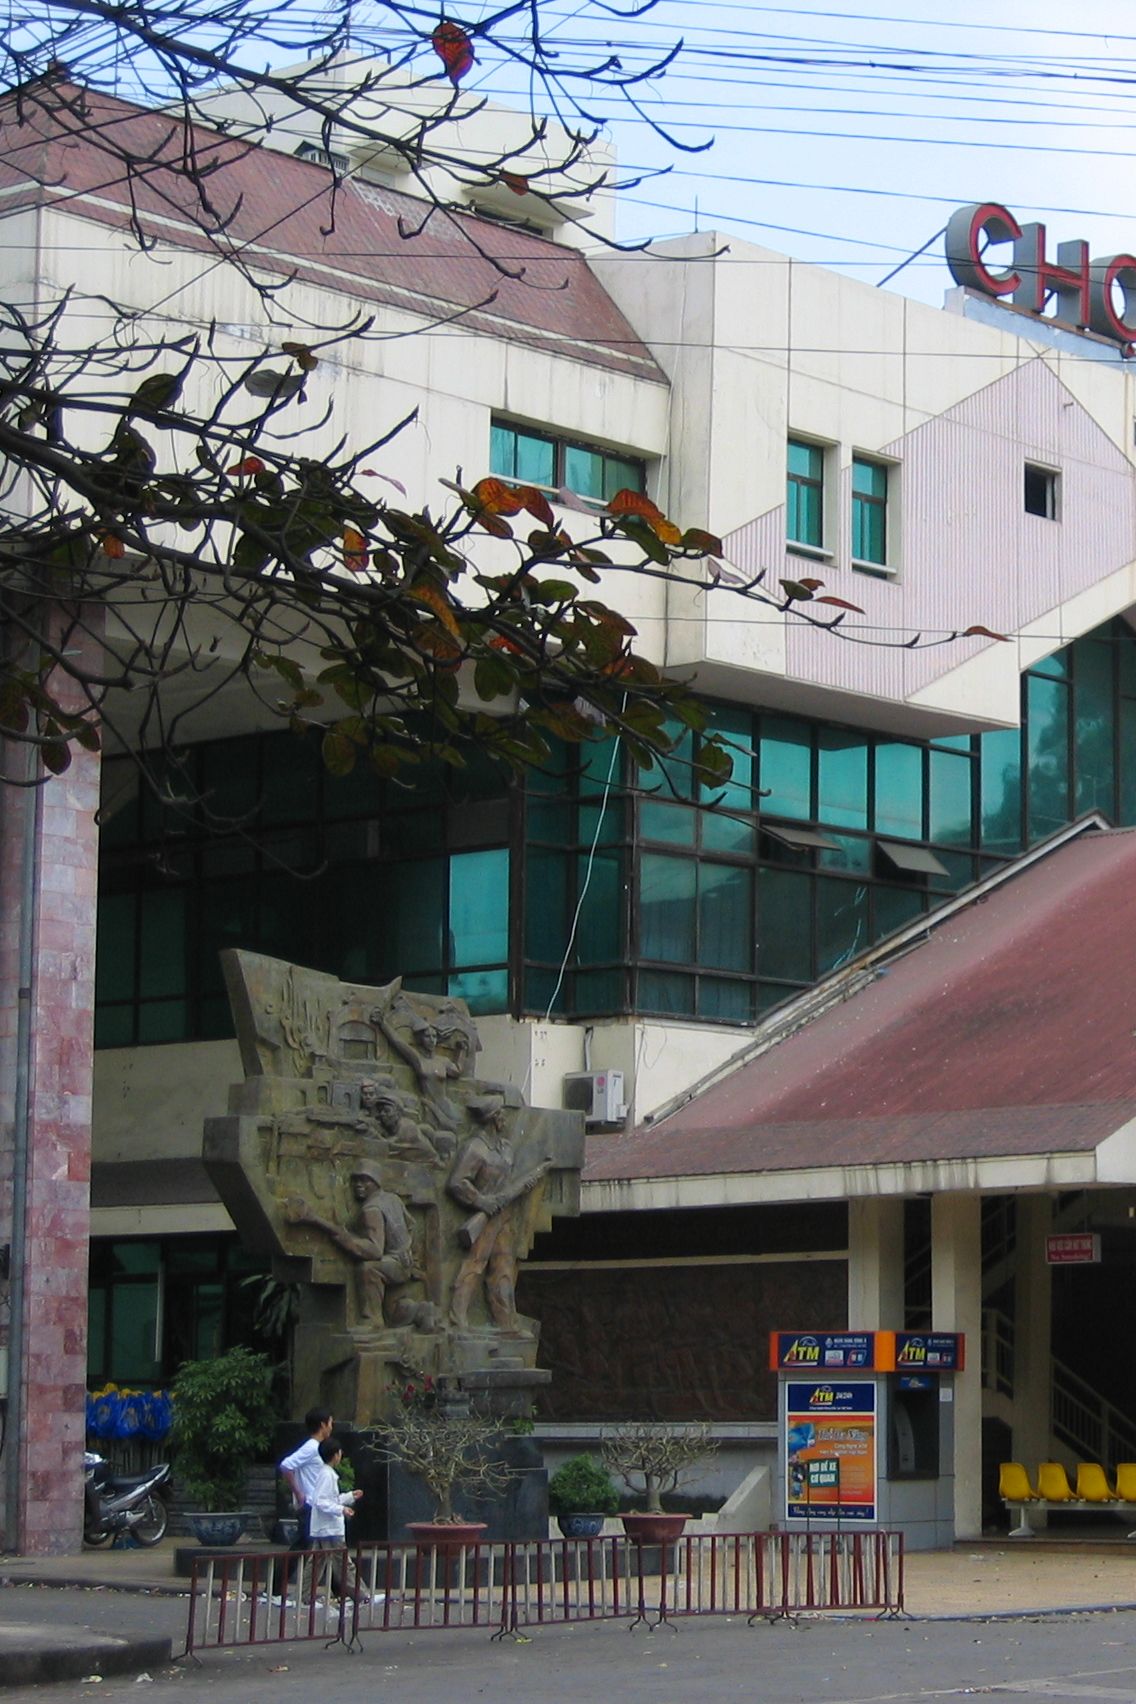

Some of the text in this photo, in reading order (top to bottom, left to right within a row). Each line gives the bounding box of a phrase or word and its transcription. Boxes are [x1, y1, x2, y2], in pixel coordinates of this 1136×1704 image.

[783, 1339, 820, 1362] ATM
[897, 1340, 926, 1362] ATM
[809, 1388, 834, 1403] ATM
